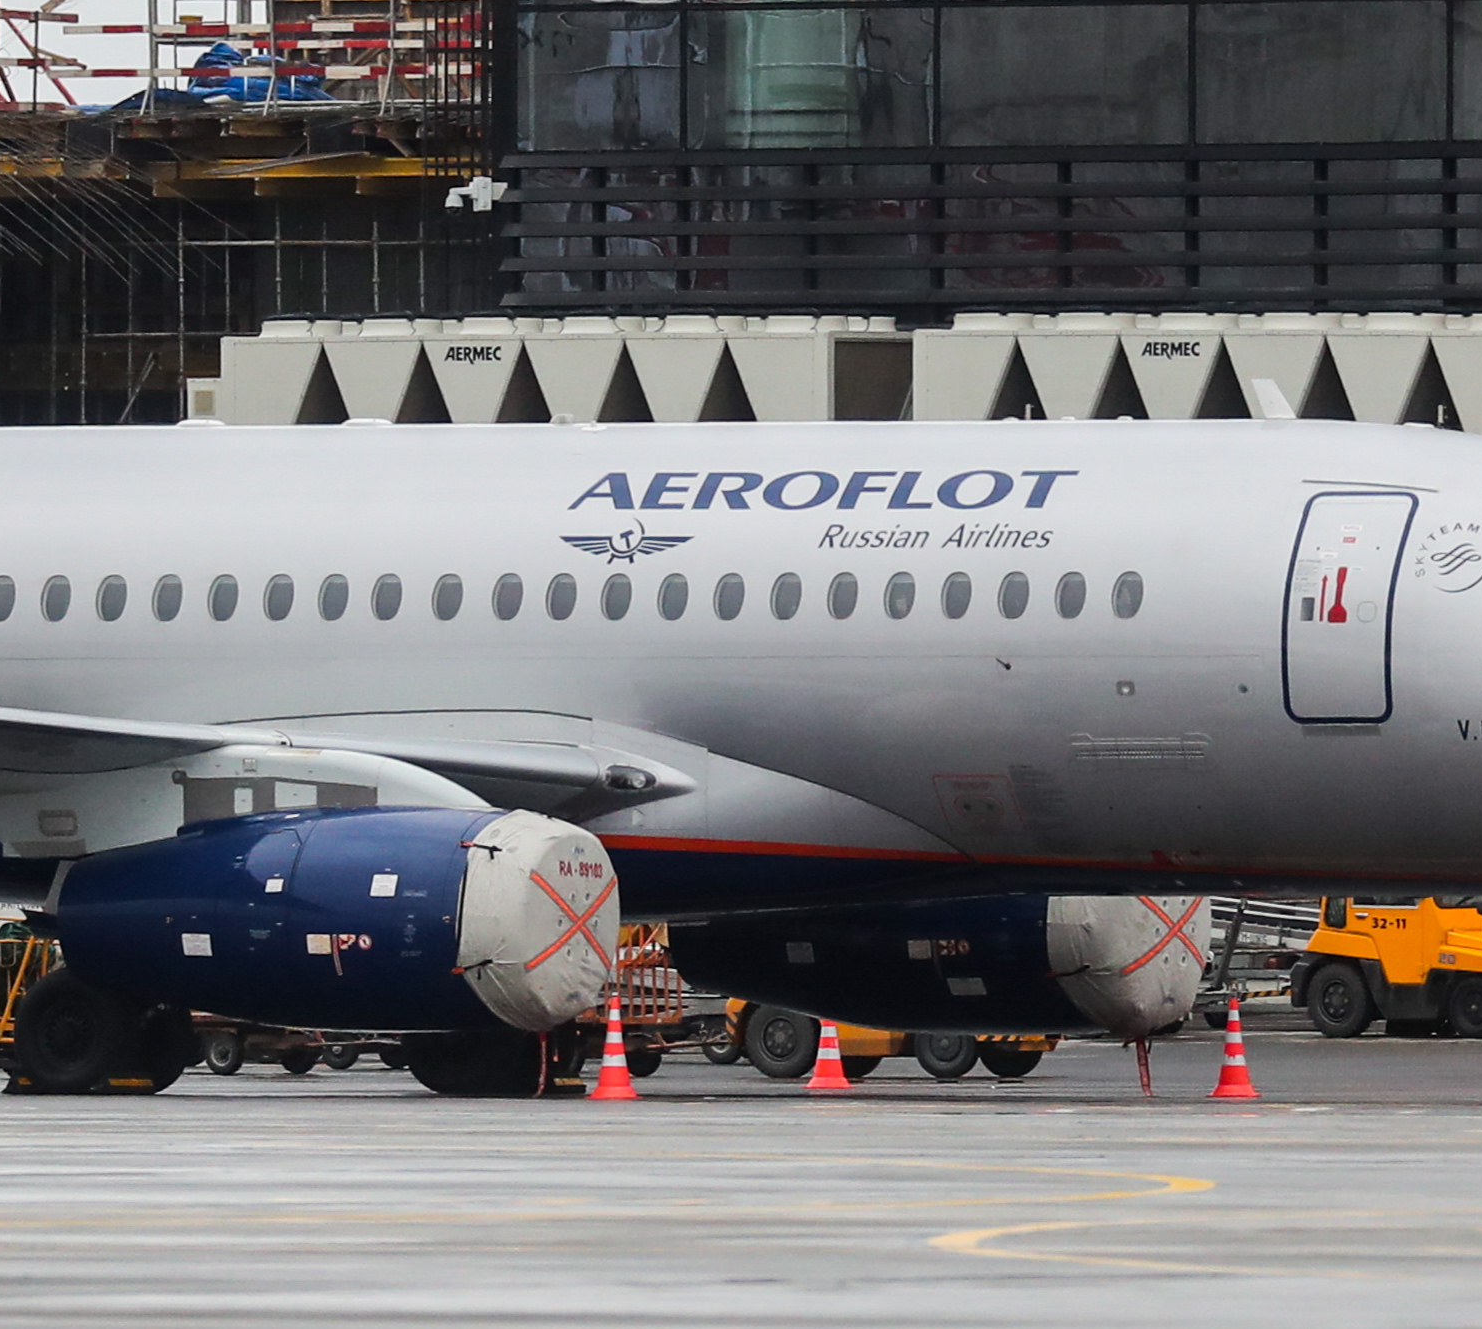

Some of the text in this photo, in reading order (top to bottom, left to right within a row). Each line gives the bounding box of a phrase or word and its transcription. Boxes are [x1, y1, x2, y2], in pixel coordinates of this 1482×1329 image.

[443, 344, 503, 363] AERMEC
[1140, 340, 1202, 358] AERMEC
[567, 469, 1080, 511] AEROFLOT
[817, 523, 1053, 550] Russian Airlines
[1415, 522, 1482, 578] SKYTEAM
[1371, 916, 1408, 930] 32-11
